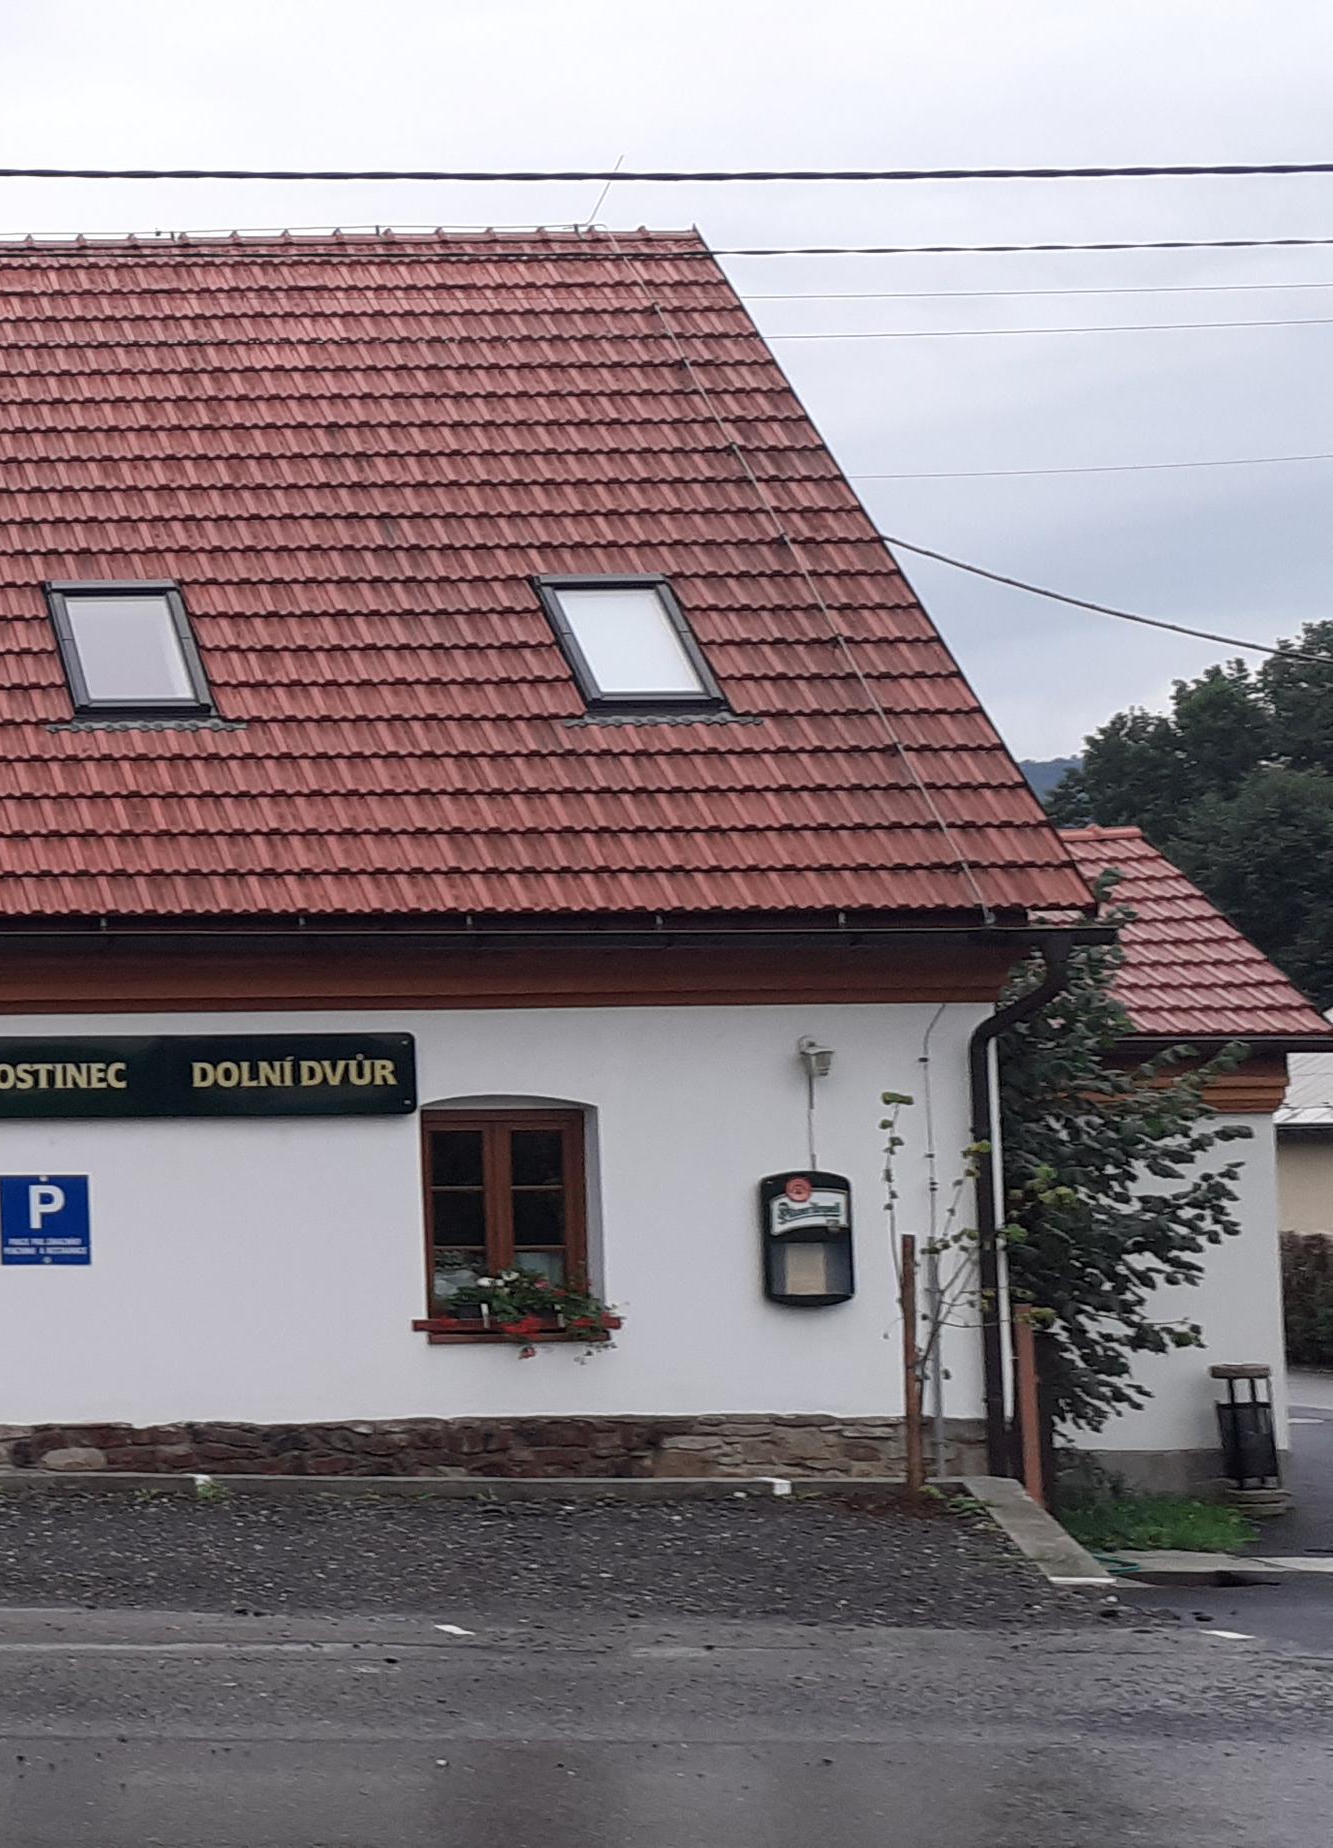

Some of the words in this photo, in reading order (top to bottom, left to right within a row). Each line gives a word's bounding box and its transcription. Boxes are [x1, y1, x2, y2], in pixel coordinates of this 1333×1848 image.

[191, 1055, 294, 1087] DOLNÍ
[300, 1053, 398, 1086] DVŮR
[28, 1184, 65, 1229] P
